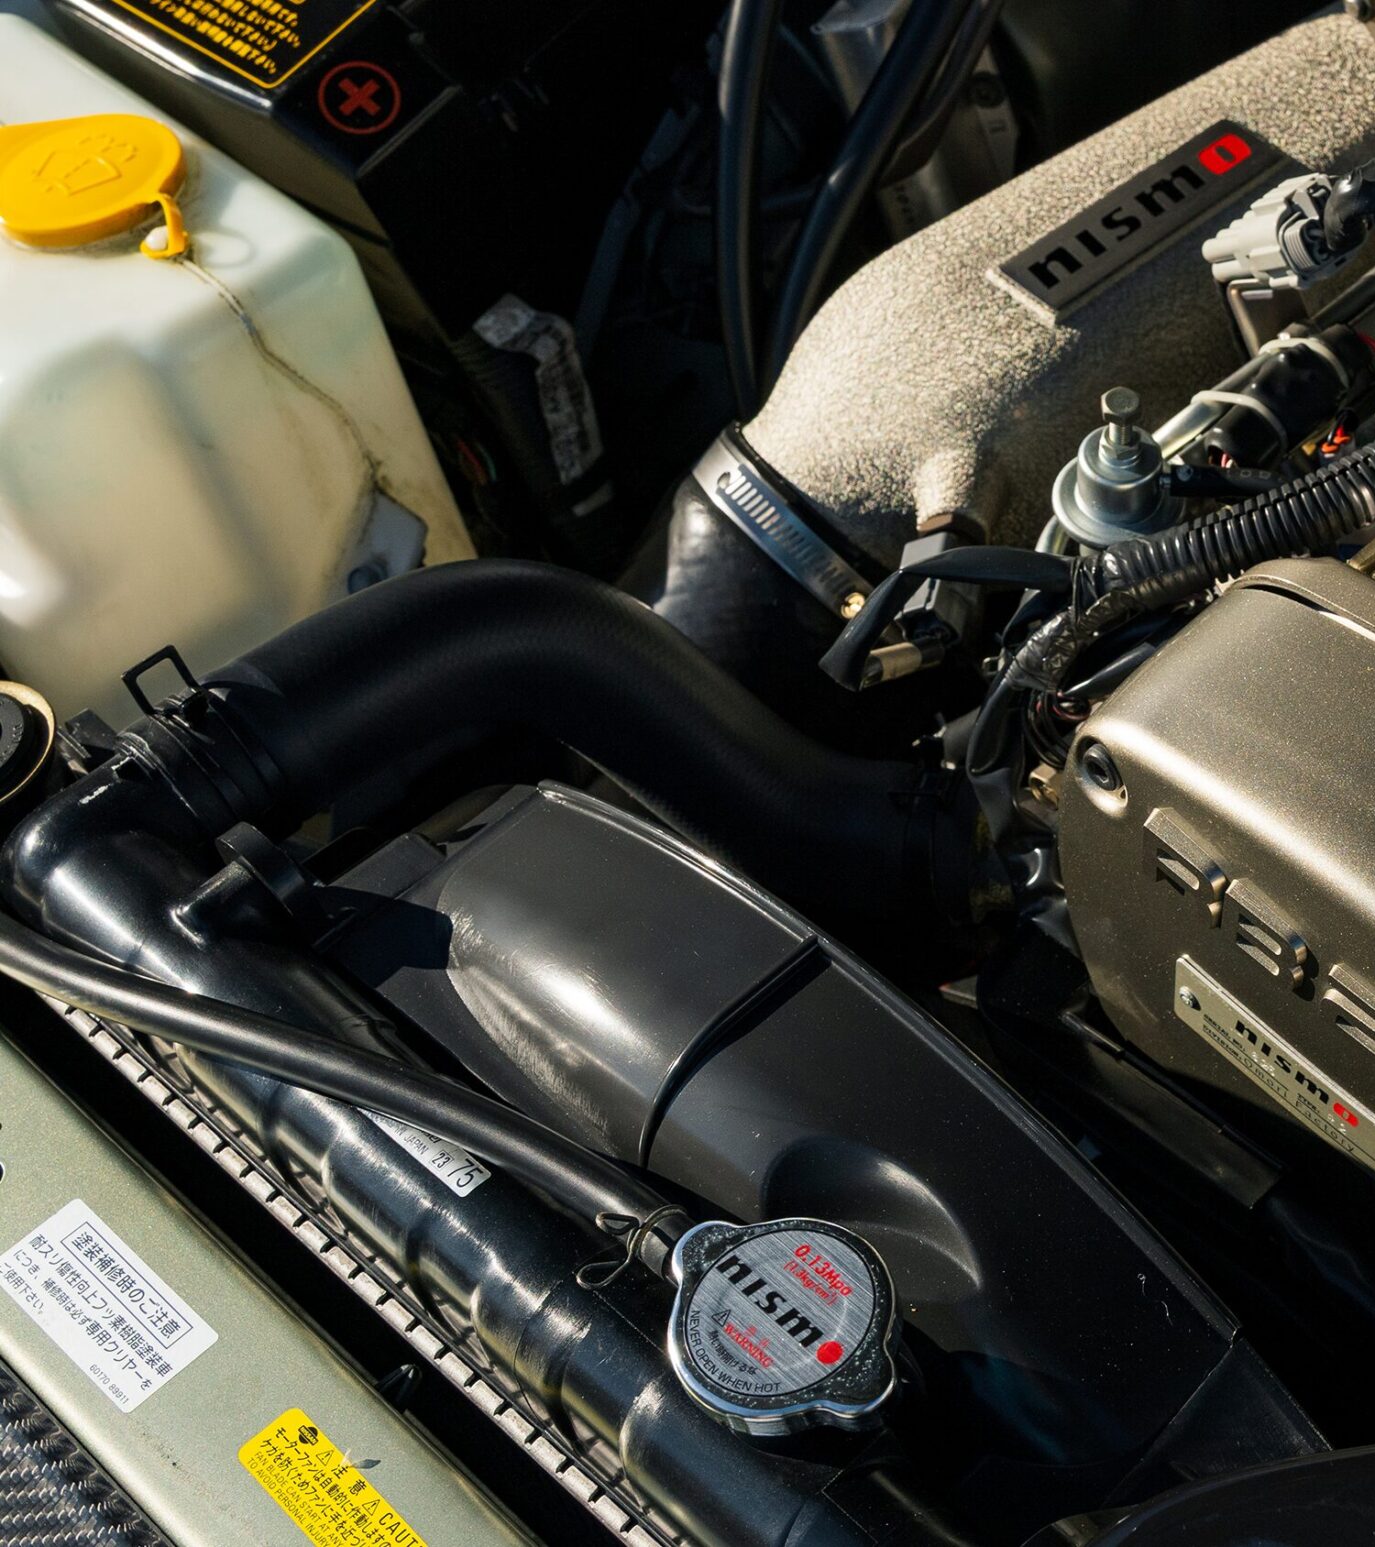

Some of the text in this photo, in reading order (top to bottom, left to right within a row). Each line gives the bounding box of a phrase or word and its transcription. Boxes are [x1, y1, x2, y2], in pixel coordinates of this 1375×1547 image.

[1028, 133, 1252, 290] nismo
[1233, 1019, 1360, 1128] nismo
[404, 1132, 429, 1155] JAPAN
[432, 1152, 450, 1169] 23
[447, 1158, 483, 1188] 75
[72, 1231, 181, 1340] 塗装補修時のご注意
[716, 1255, 844, 1365] nismo
[89, 1363, 110, 1385] 60170
[689, 1308, 781, 1392] NEVER OPEN WHEN HOT
[723, 1321, 774, 1369] WARNING
[247, 1457, 257, 1470] TO
[256, 1467, 276, 1490] AVOID
[274, 1489, 304, 1524] PERSONAL
[254, 1452, 267, 1466] FAN
[265, 1464, 289, 1488] BLADE
[285, 1484, 301, 1503] CAN
[299, 1501, 321, 1522] START
[319, 1523, 330, 1533] AT
[379, 1512, 423, 1547] CAUT
